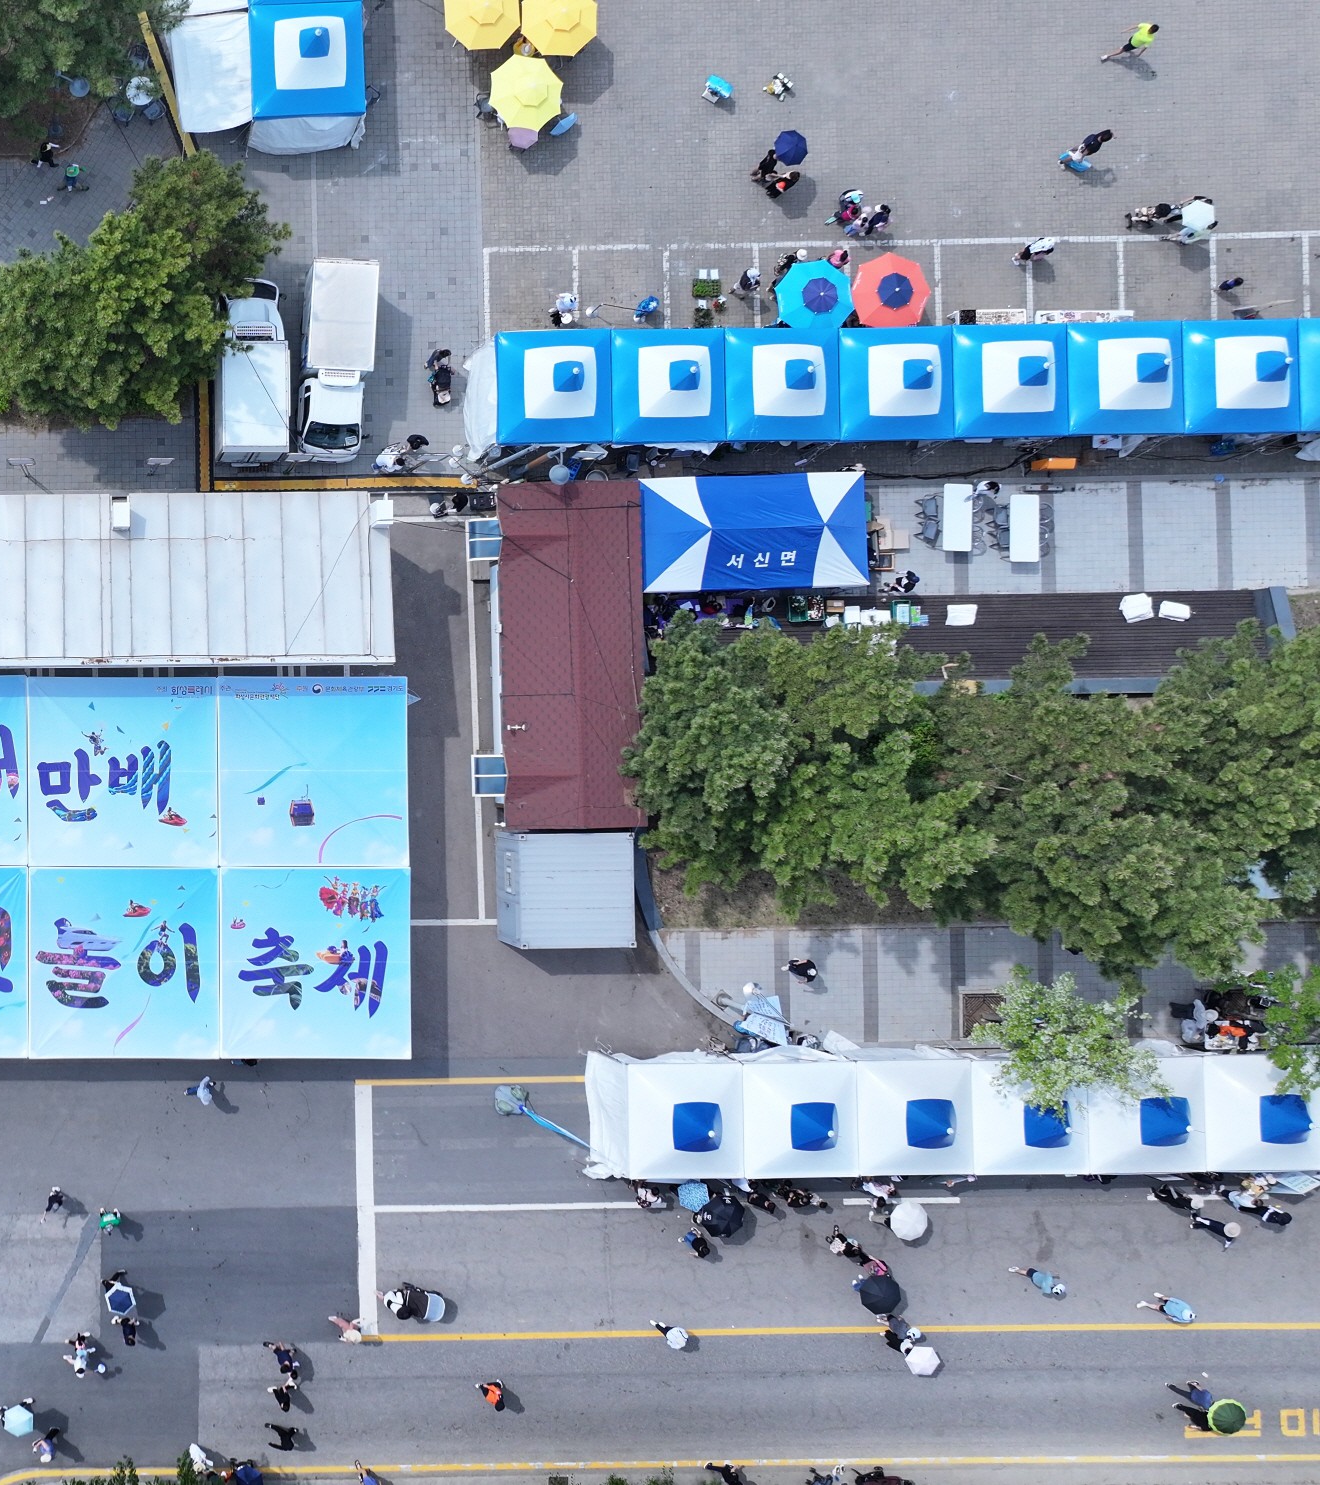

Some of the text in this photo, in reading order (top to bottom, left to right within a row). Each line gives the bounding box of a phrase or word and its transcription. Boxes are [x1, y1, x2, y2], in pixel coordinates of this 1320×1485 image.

[726, 550, 797, 569] 서신면
[36, 740, 172, 822] 만배
[237, 927, 388, 1019] 축제
